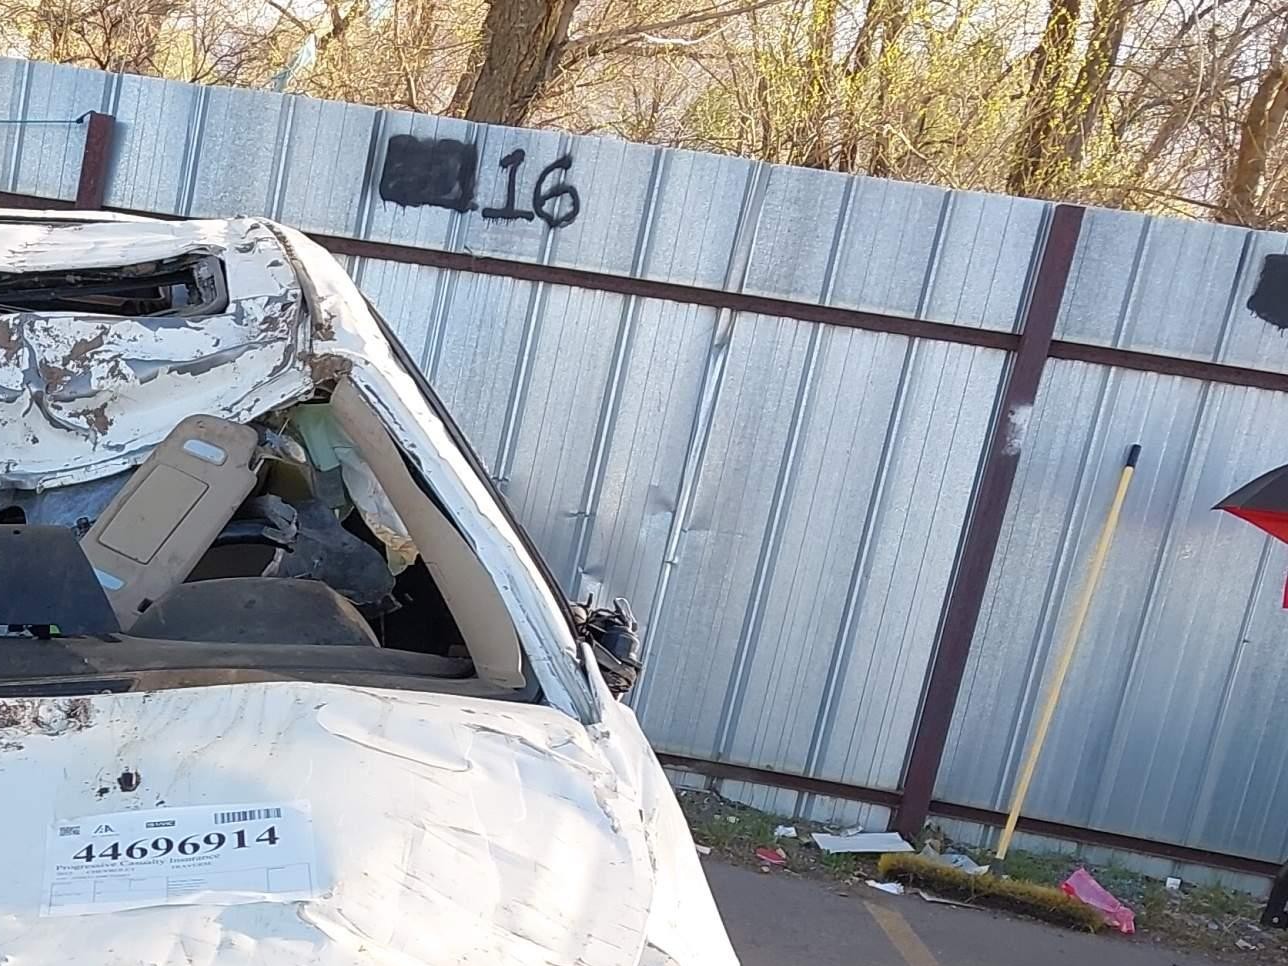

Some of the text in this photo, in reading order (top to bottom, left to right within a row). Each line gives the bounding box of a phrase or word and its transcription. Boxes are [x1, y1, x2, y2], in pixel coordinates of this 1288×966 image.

[482, 149, 580, 227] 16
[72, 825, 280, 862] 44696914
[56, 862, 117, 872] Progressive
